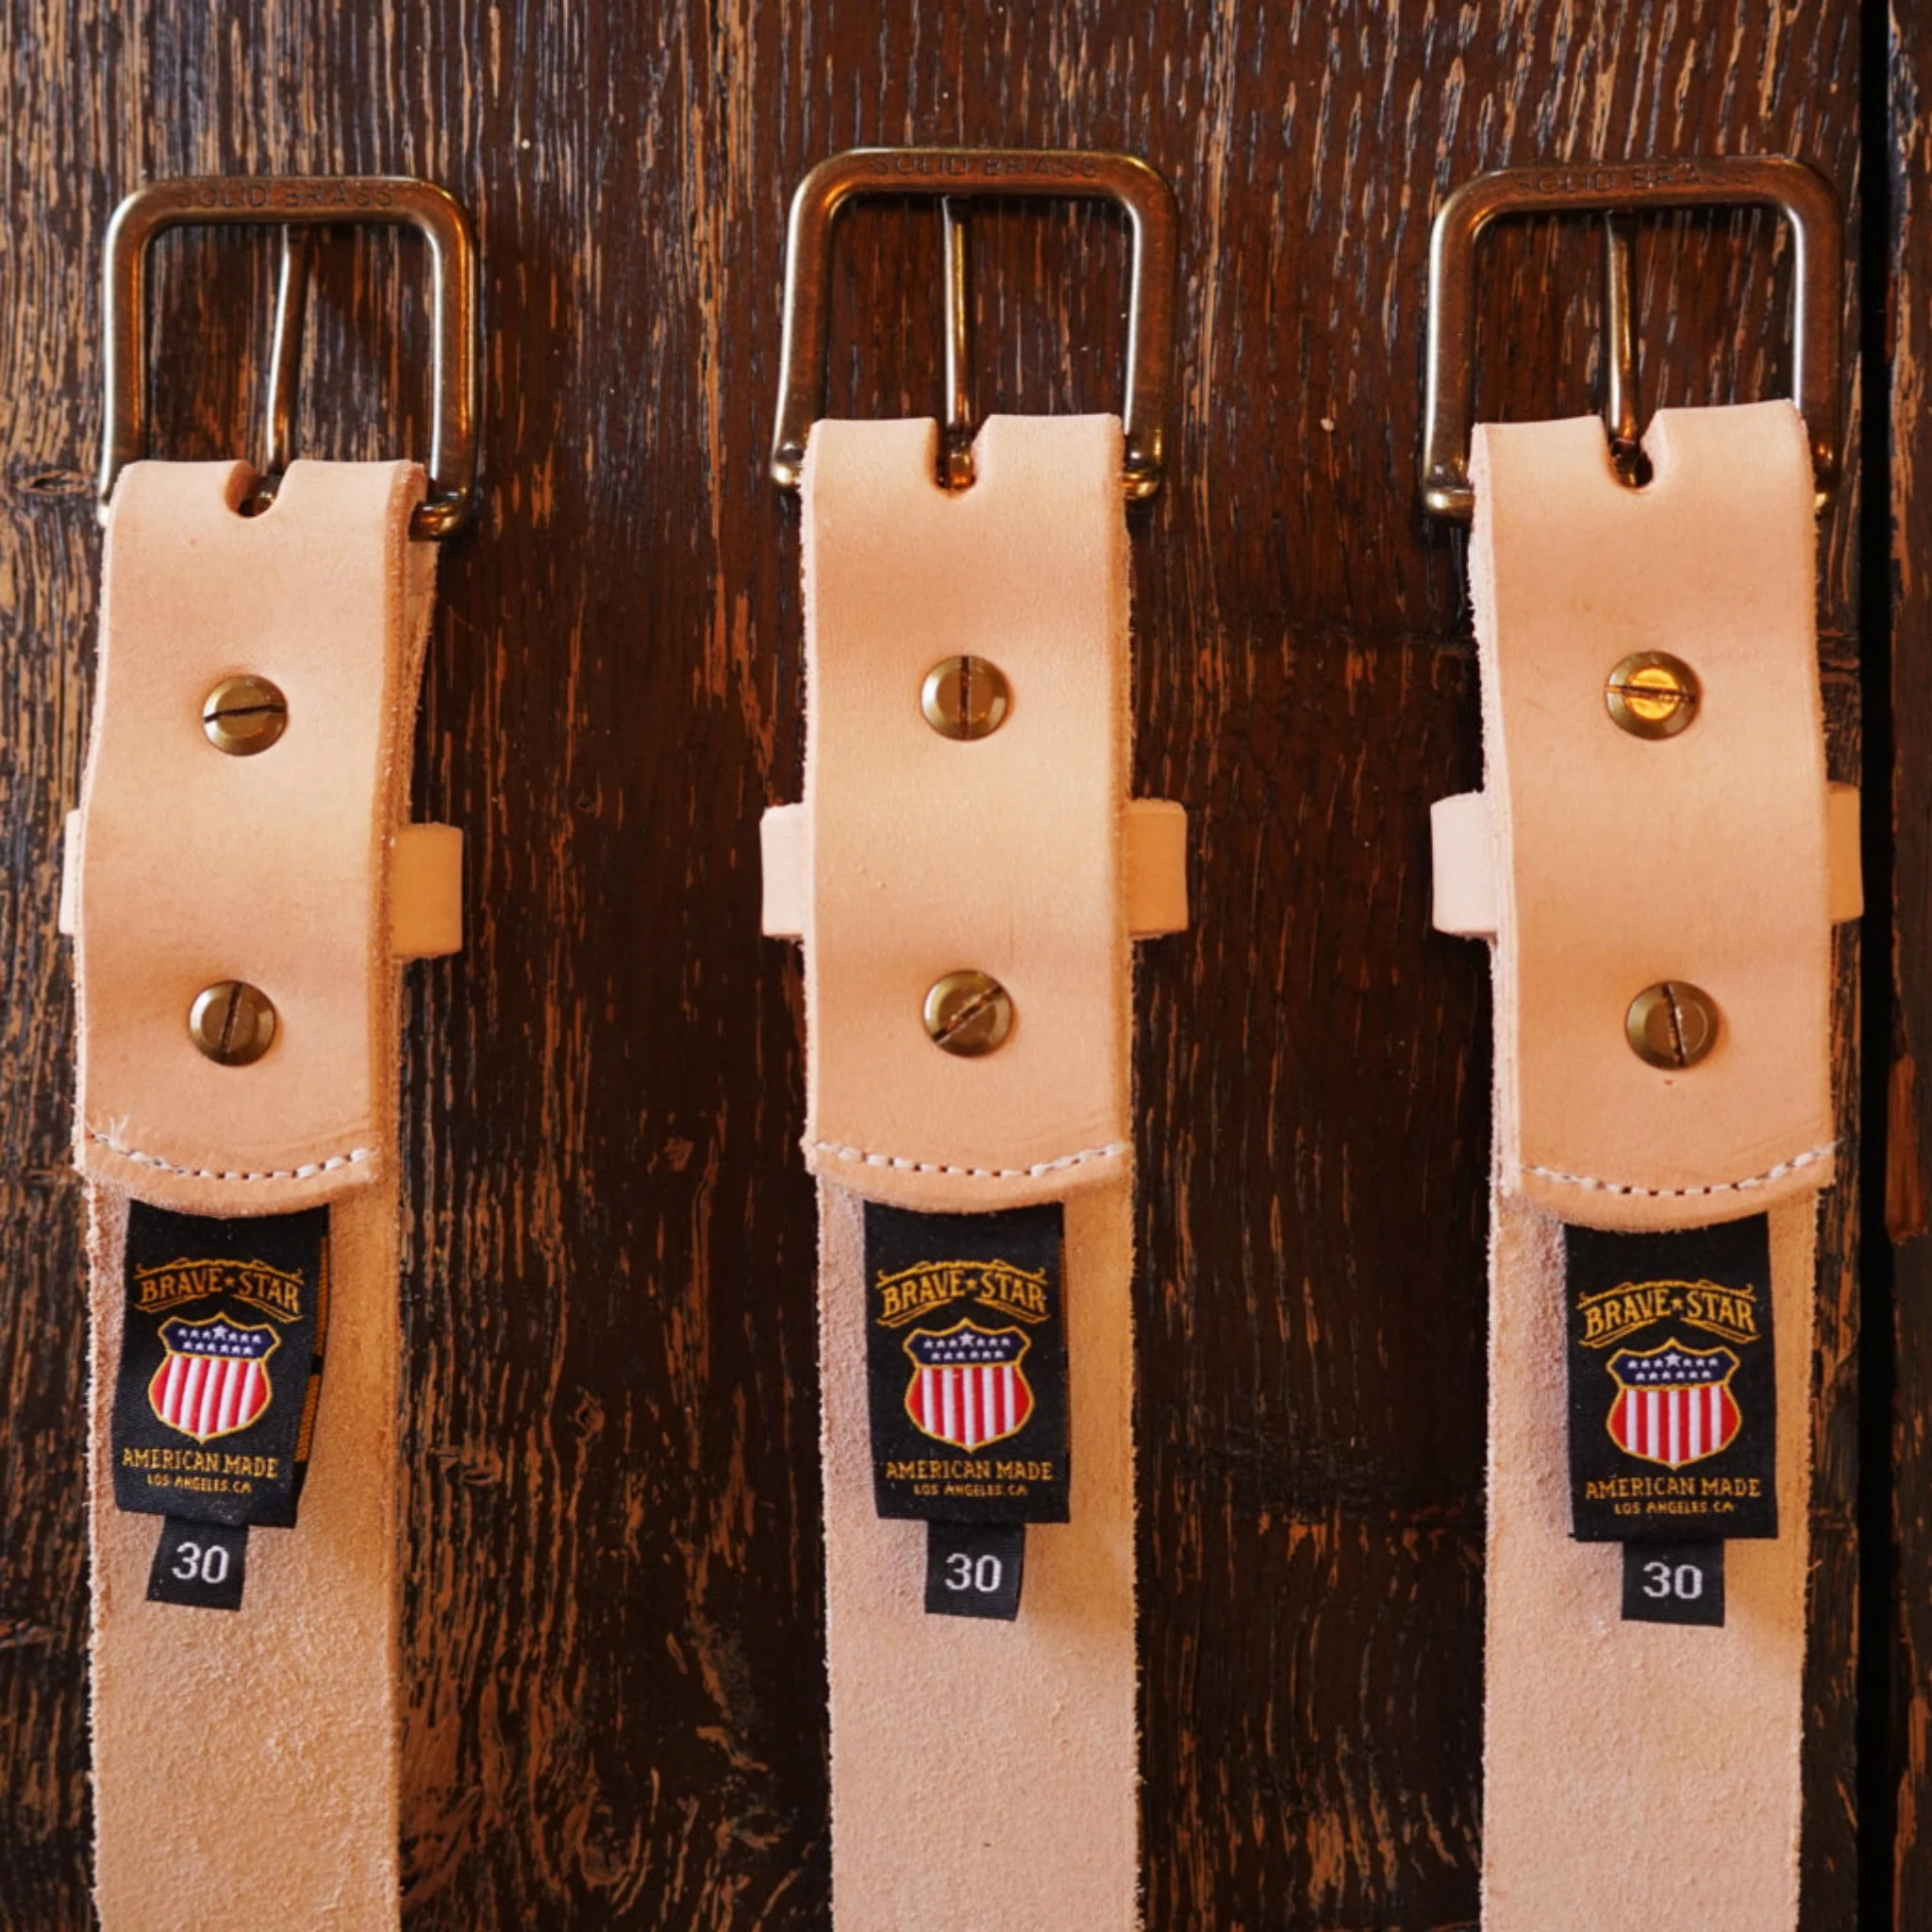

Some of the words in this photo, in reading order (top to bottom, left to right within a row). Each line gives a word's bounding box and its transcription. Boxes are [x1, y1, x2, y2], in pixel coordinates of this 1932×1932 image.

[142, 1268, 224, 1302] BRAVE
[239, 1270, 300, 1313] STAR
[882, 1270, 966, 1317] BRAVE
[980, 1271, 1045, 1312] STAR
[1584, 1288, 1671, 1339] BRAVE
[1686, 1290, 1757, 1333] STAR
[122, 1448, 220, 1473] AMERICAN
[223, 1455, 280, 1479] MADE
[885, 1459, 991, 1480] AMERICAN
[996, 1460, 1054, 1481] MADE
[146, 1474, 170, 1487] LOS
[232, 1480, 254, 1494] CA
[913, 1484, 939, 1495] LOS
[1008, 1484, 1028, 1496] CA
[1585, 1476, 1695, 1500] AMERICAN
[1701, 1477, 1761, 1498] MADE
[1614, 1502, 1641, 1515] LOS
[1712, 1500, 1735, 1513] CA
[172, 1541, 230, 1584] 30
[945, 1553, 1003, 1592] 30
[1642, 1561, 1704, 1600] 30
